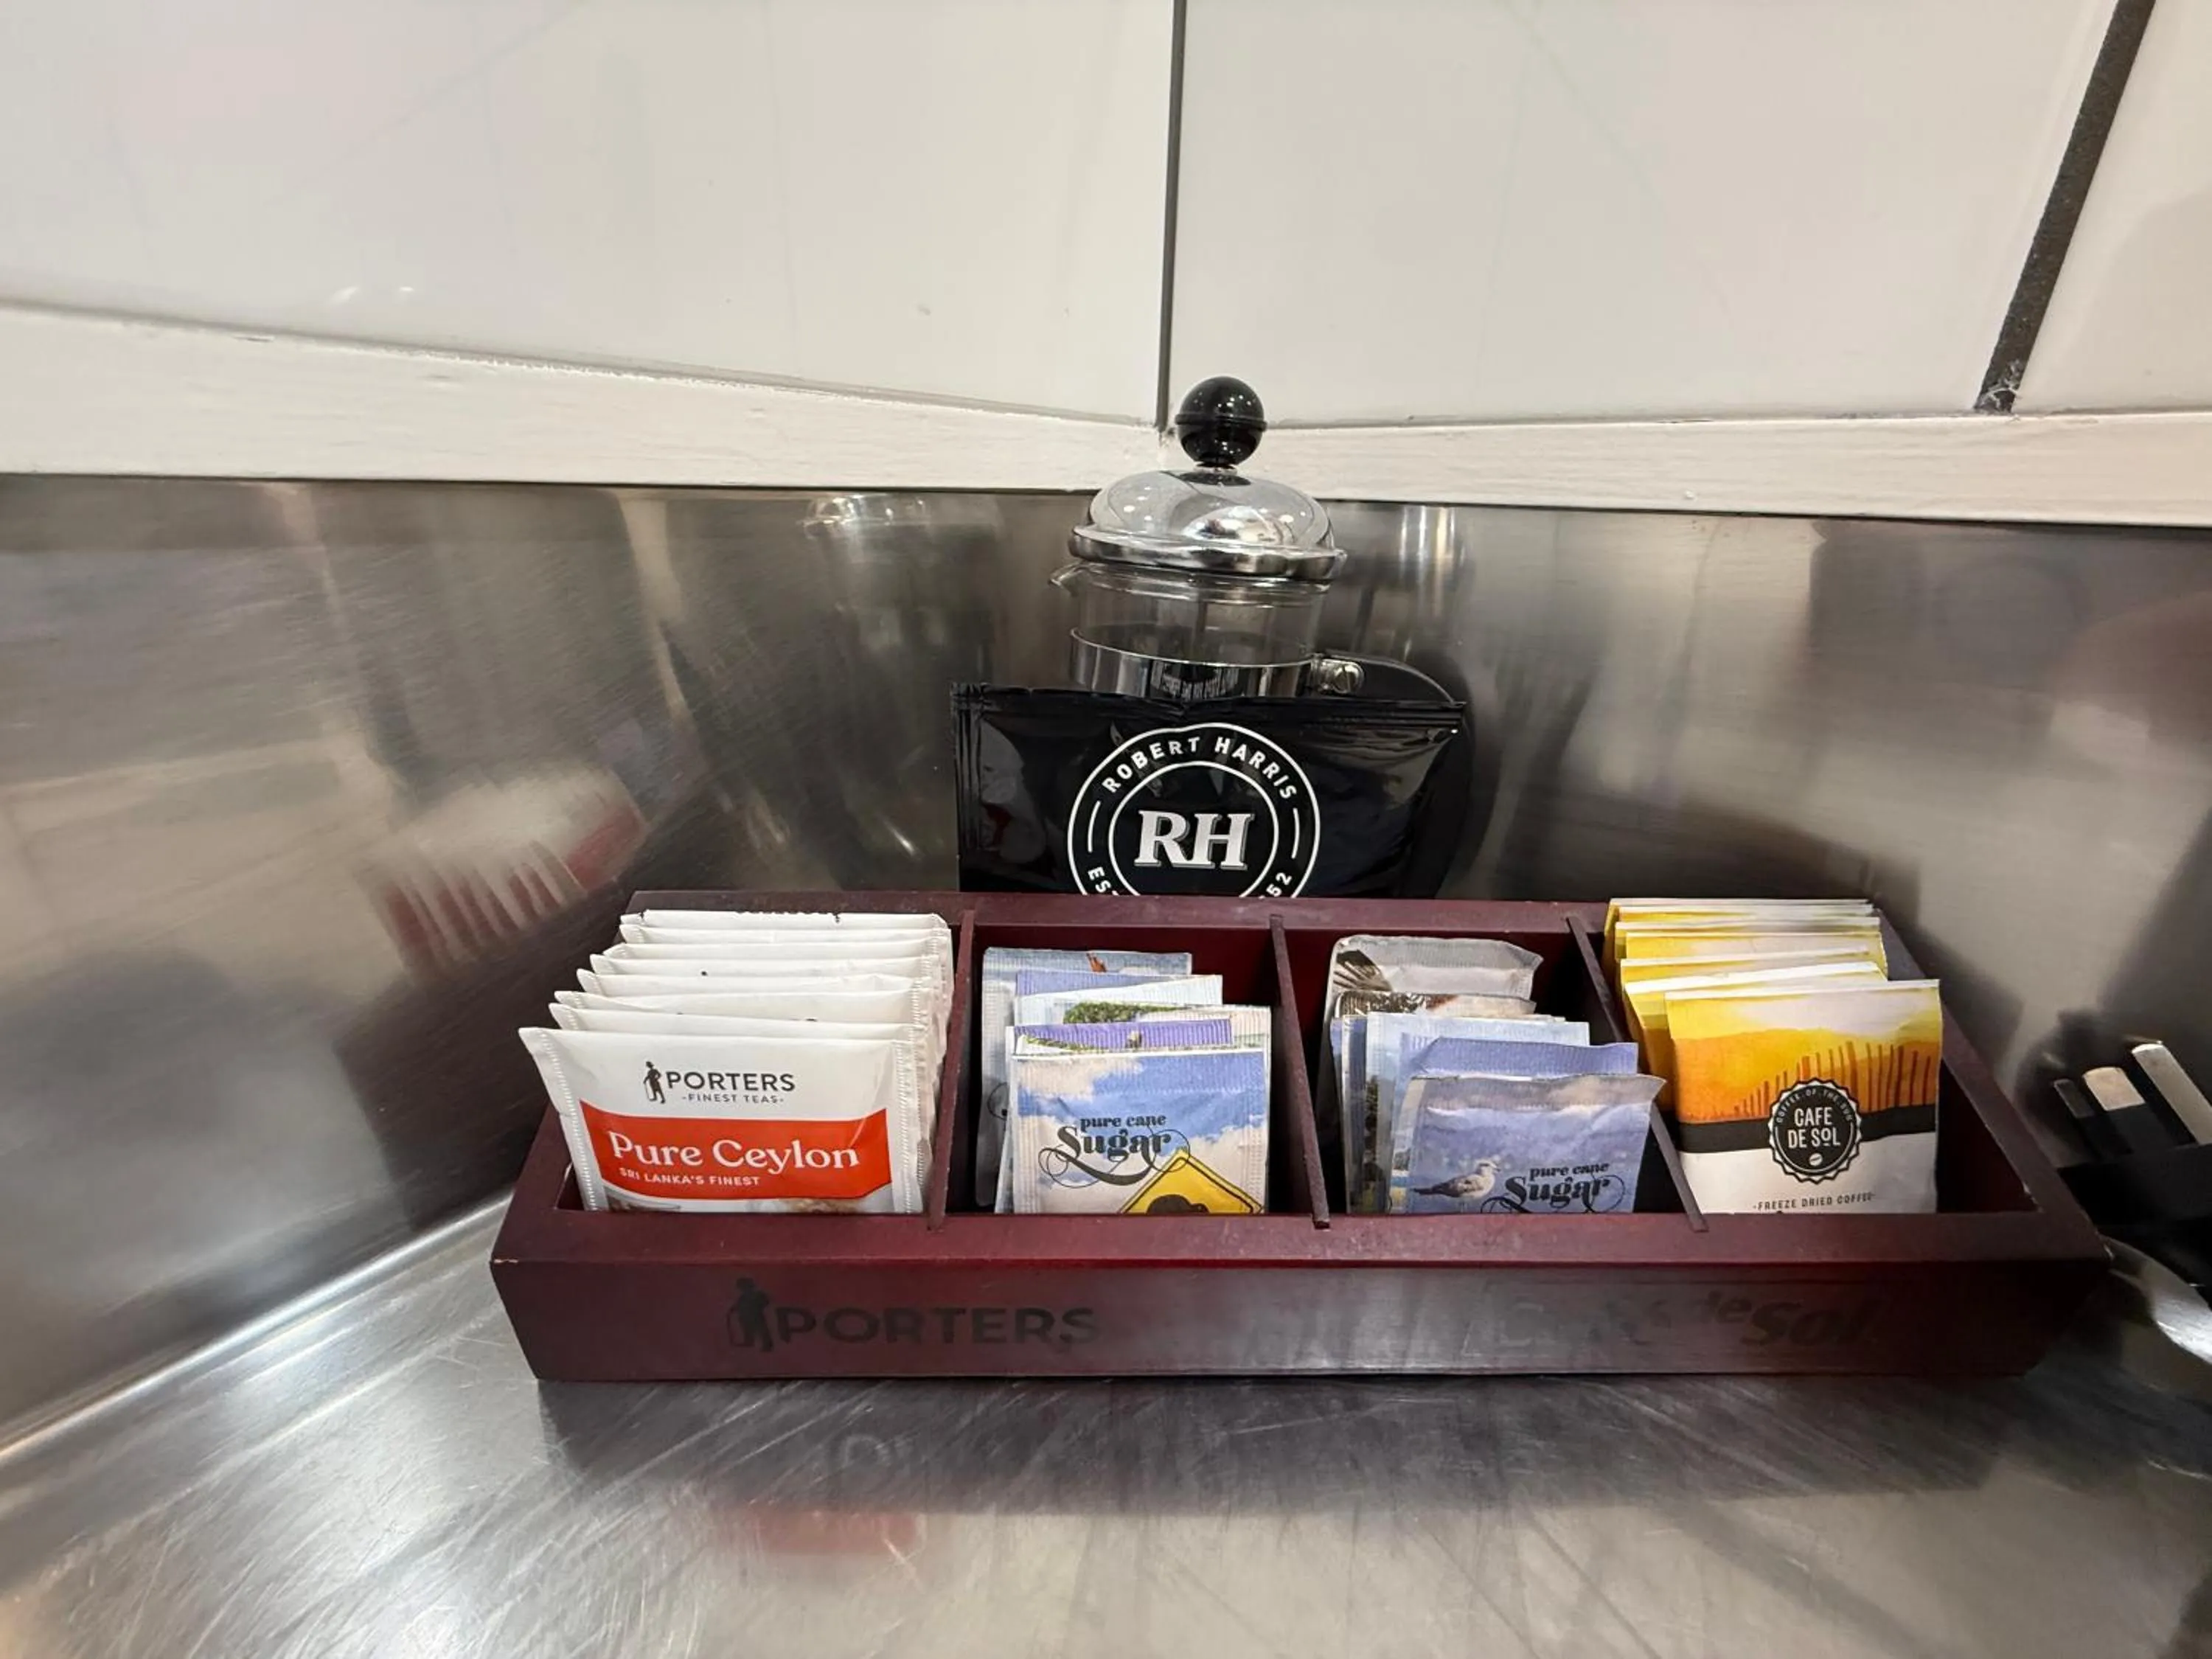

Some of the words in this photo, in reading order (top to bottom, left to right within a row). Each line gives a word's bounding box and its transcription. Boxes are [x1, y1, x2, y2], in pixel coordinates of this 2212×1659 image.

[1102, 737, 1200, 793] ROBERT
[1214, 737, 1298, 799] HARRIS
[1134, 810, 1255, 870] RH
[1088, 866, 1119, 896] ES
[1258, 872, 1293, 899] 52
[666, 1071, 796, 1092] PORTERS
[1079, 1116, 1121, 1133] pure
[1127, 1114, 1166, 1127] cane
[1794, 1107, 1833, 1127] CAFE
[608, 1130, 703, 1166] Pure
[712, 1138, 860, 1175] Ceylon
[1043, 1126, 1180, 1180] Sugar
[1787, 1129, 1806, 1149] DE
[618, 1167, 640, 1180] SRI
[644, 1172, 705, 1186] LANKA'S
[709, 1175, 760, 1186] FINEST
[1530, 1166, 1570, 1180] pure
[1572, 1163, 1610, 1175] cane
[1493, 1175, 1618, 1213] Sugar
[774, 1306, 1102, 1344] PORTERS
